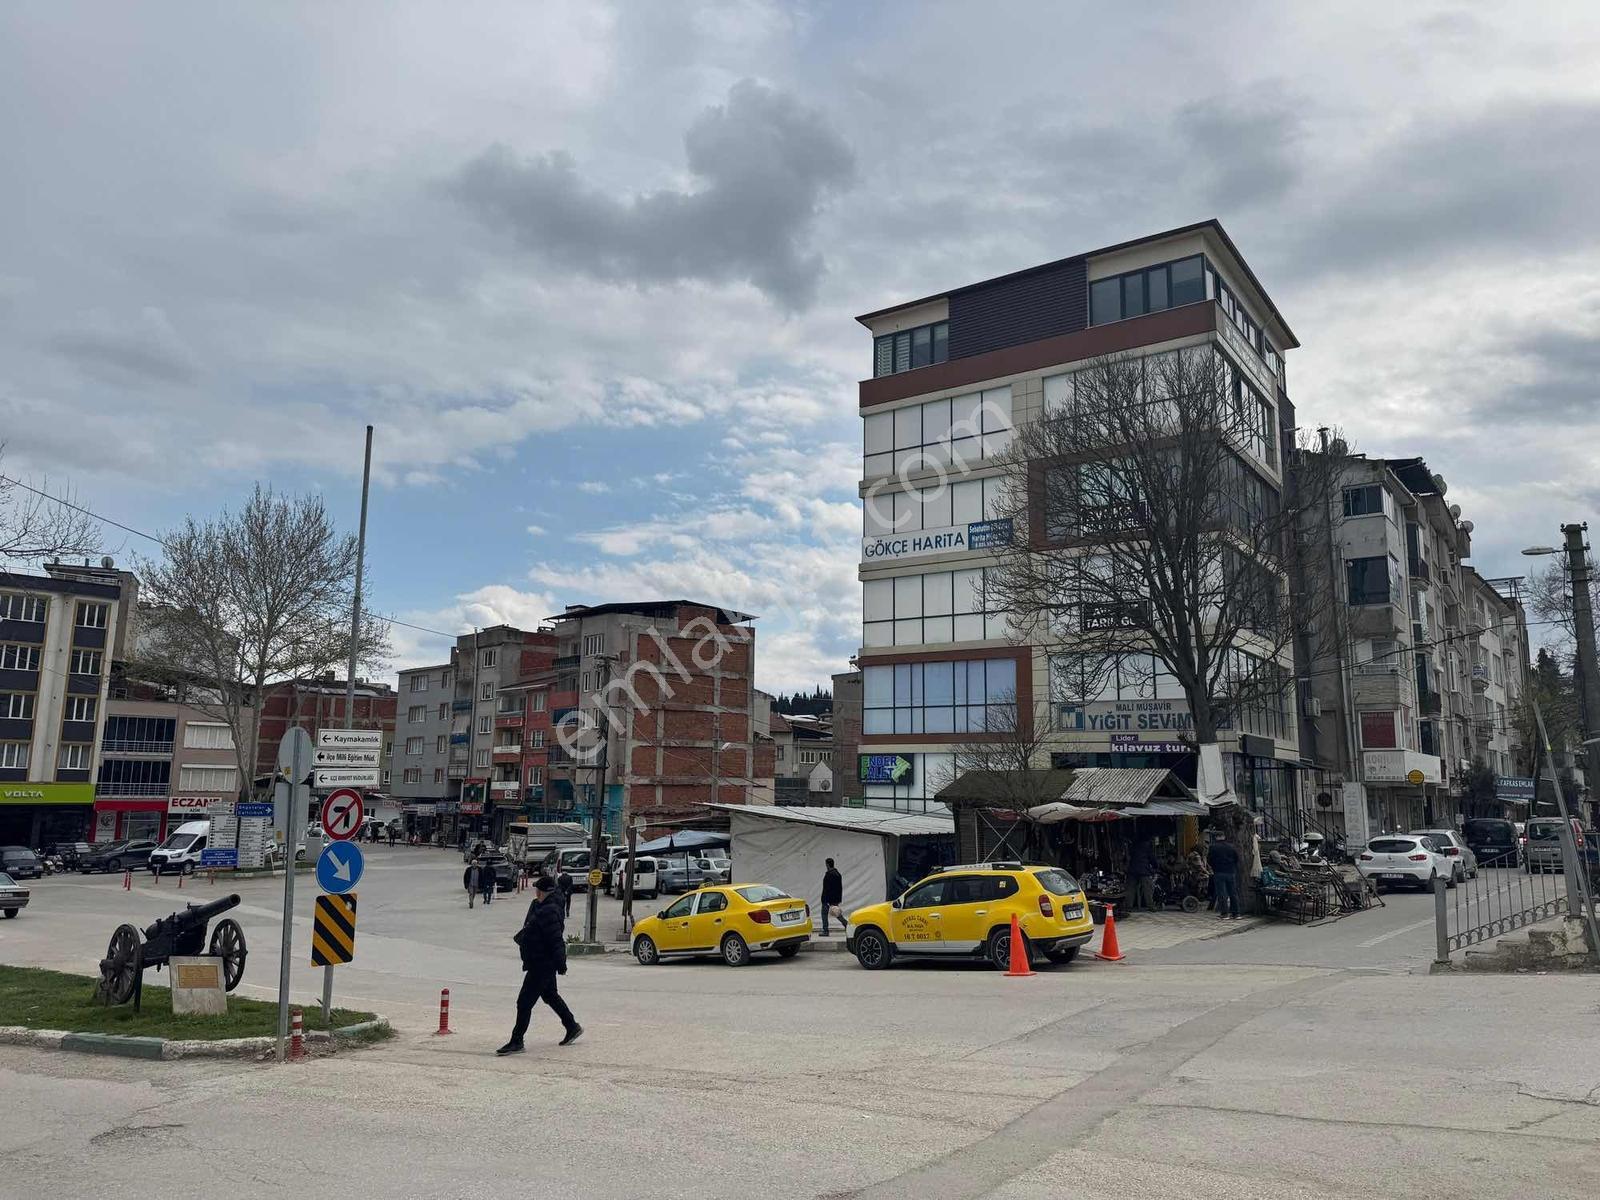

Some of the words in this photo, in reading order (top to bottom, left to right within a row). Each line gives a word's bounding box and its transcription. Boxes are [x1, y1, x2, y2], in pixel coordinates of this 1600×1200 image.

[864, 539, 908, 558] GÖKÇE
[333, 735, 379, 744] Kaymakamlık
[1111, 743, 1162, 752] kılavuz
[347, 753, 363, 763] Eğitim
[860, 755, 897, 768] ENDER
[860, 767, 895, 779] PALET
[4, 790, 44, 800] VOLTA
